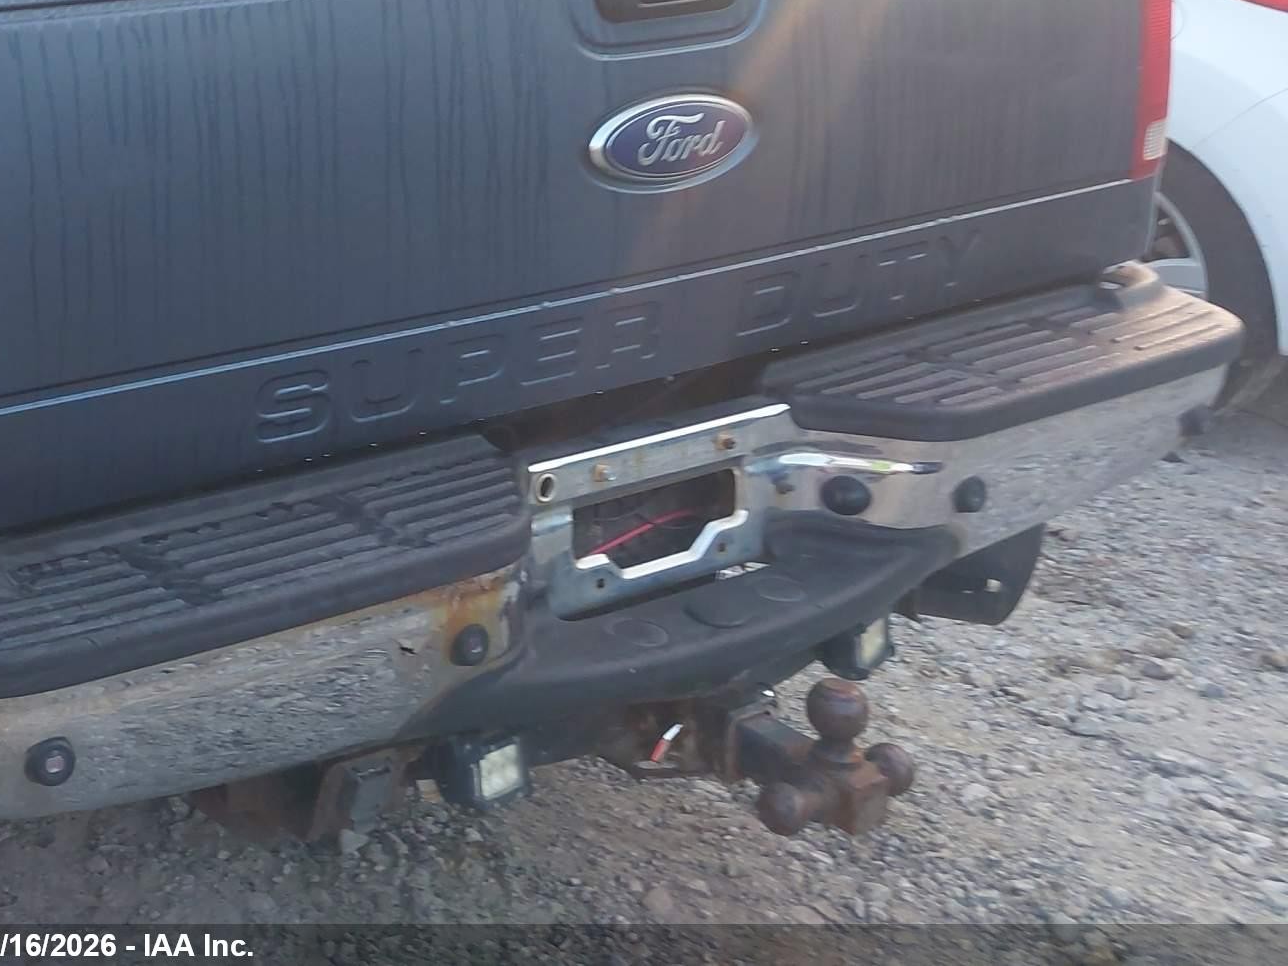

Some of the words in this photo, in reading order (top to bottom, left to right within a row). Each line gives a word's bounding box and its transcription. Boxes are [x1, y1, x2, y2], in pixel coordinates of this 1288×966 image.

[637, 112, 726, 166] Ford
[255, 300, 661, 444] SUPER
[735, 229, 982, 337] DUTY
